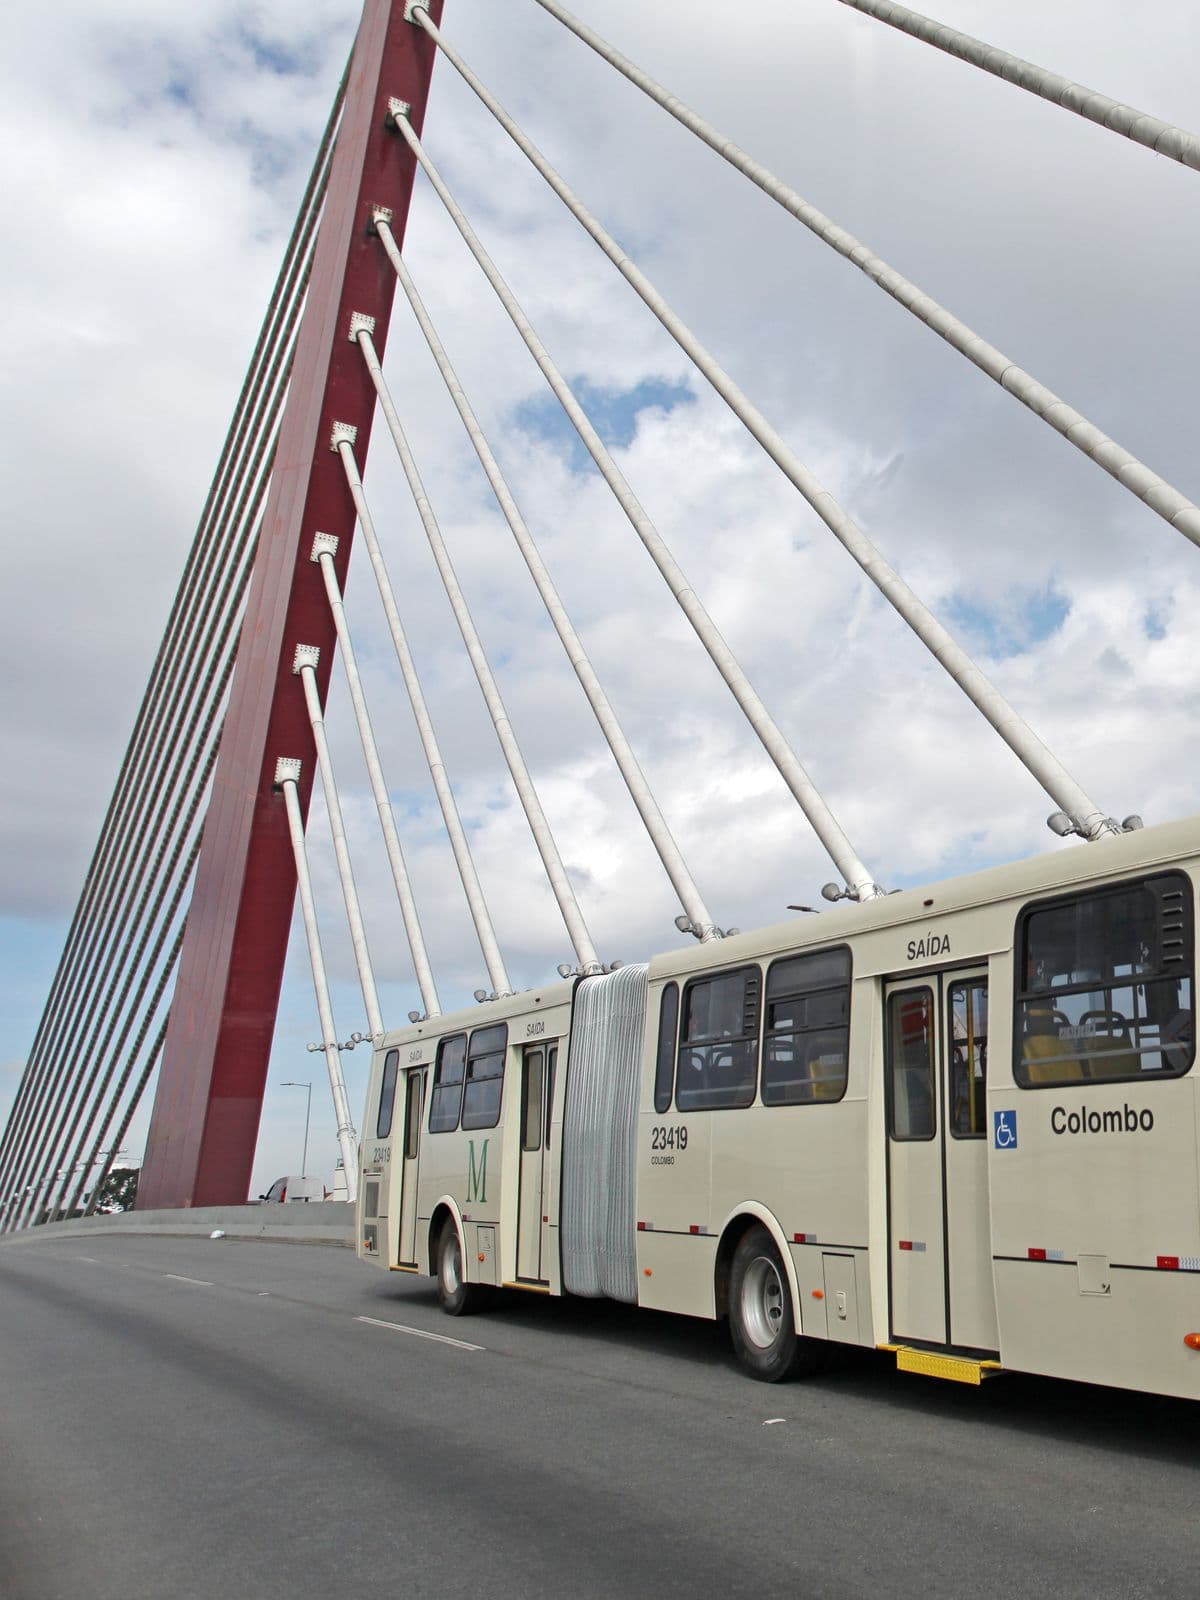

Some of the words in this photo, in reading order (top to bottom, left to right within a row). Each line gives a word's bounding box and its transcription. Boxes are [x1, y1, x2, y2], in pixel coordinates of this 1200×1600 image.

[907, 931, 951, 961] SAÍDA
[1051, 1103, 1154, 1135] Colombo
[651, 1126, 688, 1150] 23419
[373, 1147, 391, 1163] 23419
[466, 1139, 490, 1203] M
